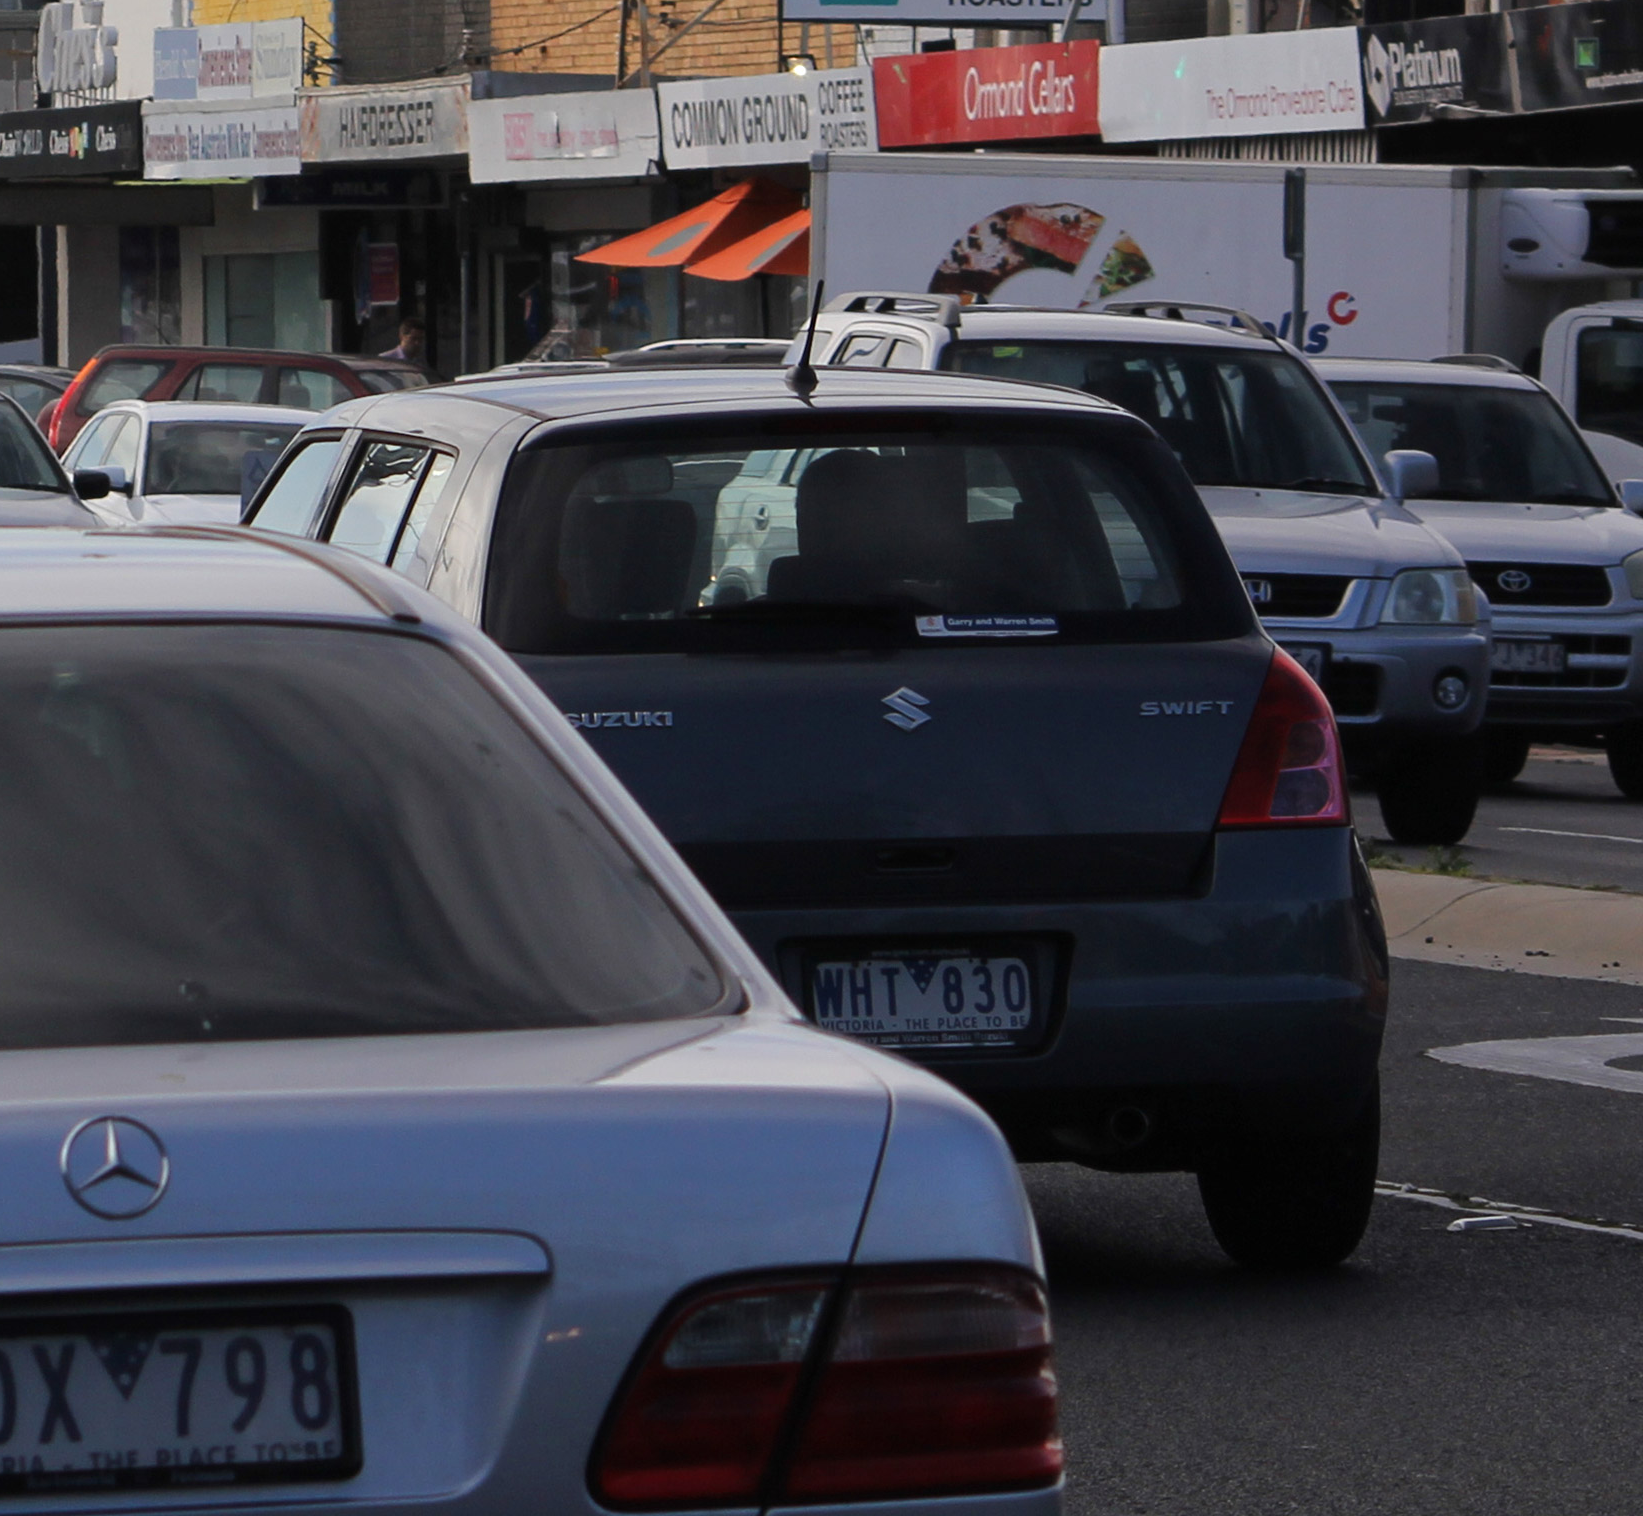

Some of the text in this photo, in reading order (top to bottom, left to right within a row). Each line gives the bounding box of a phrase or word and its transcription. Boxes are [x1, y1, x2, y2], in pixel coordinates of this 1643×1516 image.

[1388, 40, 1462, 94] Platinum
[818, 78, 865, 115] COFFEE
[965, 59, 1076, 121] Ormond Cellars
[338, 100, 435, 149] HAIRDRESSER
[671, 93, 809, 149] COMMON GROUND
[820, 121, 868, 149] ROASTERS
[947, 616, 1056, 627] Garry and Warren Smith
[565, 711, 673, 728] SUZUKI
[1139, 701, 1234, 715] SWIFT
[816, 964, 1027, 1018] WHT 830
[821, 1019, 885, 1032] VICTORIA
[905, 1017, 930, 1030] THE
[938, 1016, 978, 1029] PLACE
[986, 1015, 1003, 1027] TO
[1010, 1014, 1028, 1026] BE
[159, 1334, 334, 1437] 798
